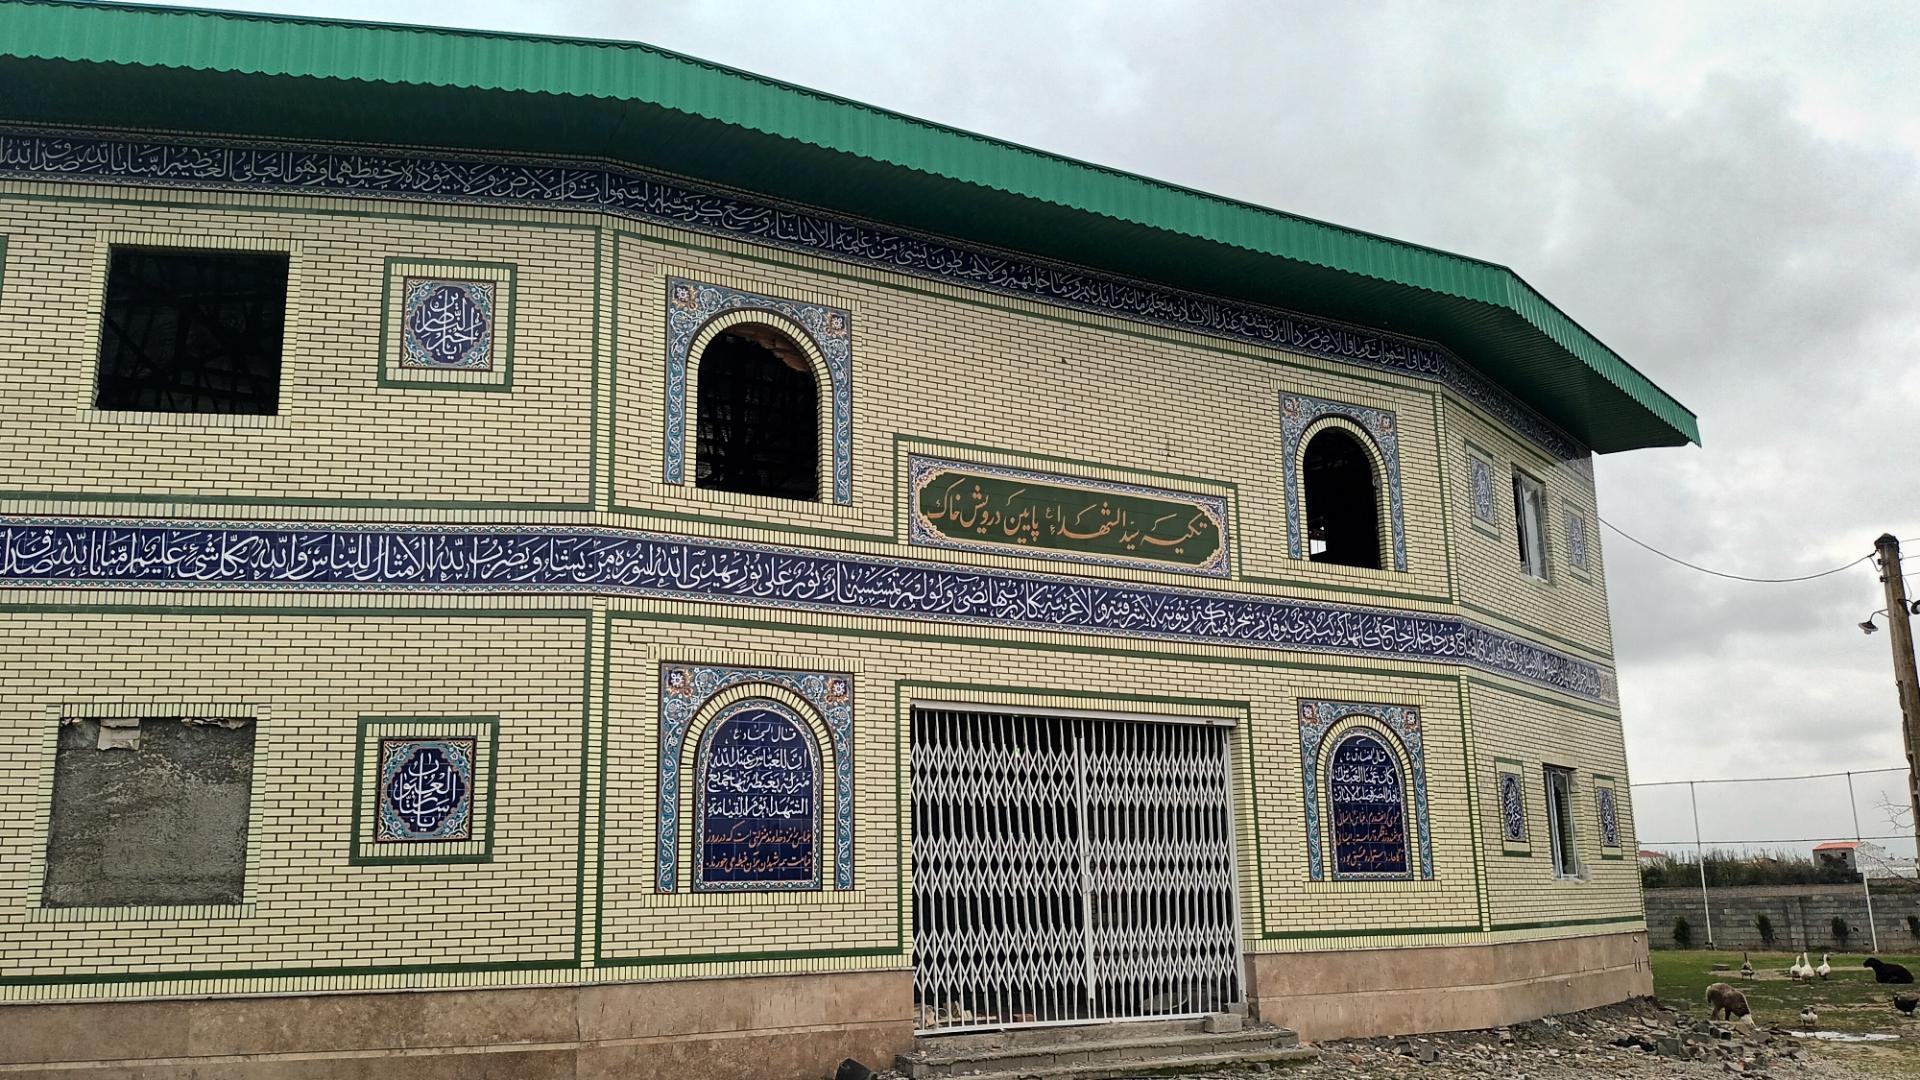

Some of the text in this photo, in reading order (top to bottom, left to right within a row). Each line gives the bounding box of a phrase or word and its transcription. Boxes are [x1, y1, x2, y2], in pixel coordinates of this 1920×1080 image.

[927, 477, 966, 520] خاک
[960, 485, 1001, 534] درویش
[1119, 523, 1141, 550] سید
[1140, 512, 1208, 554] تکیه
